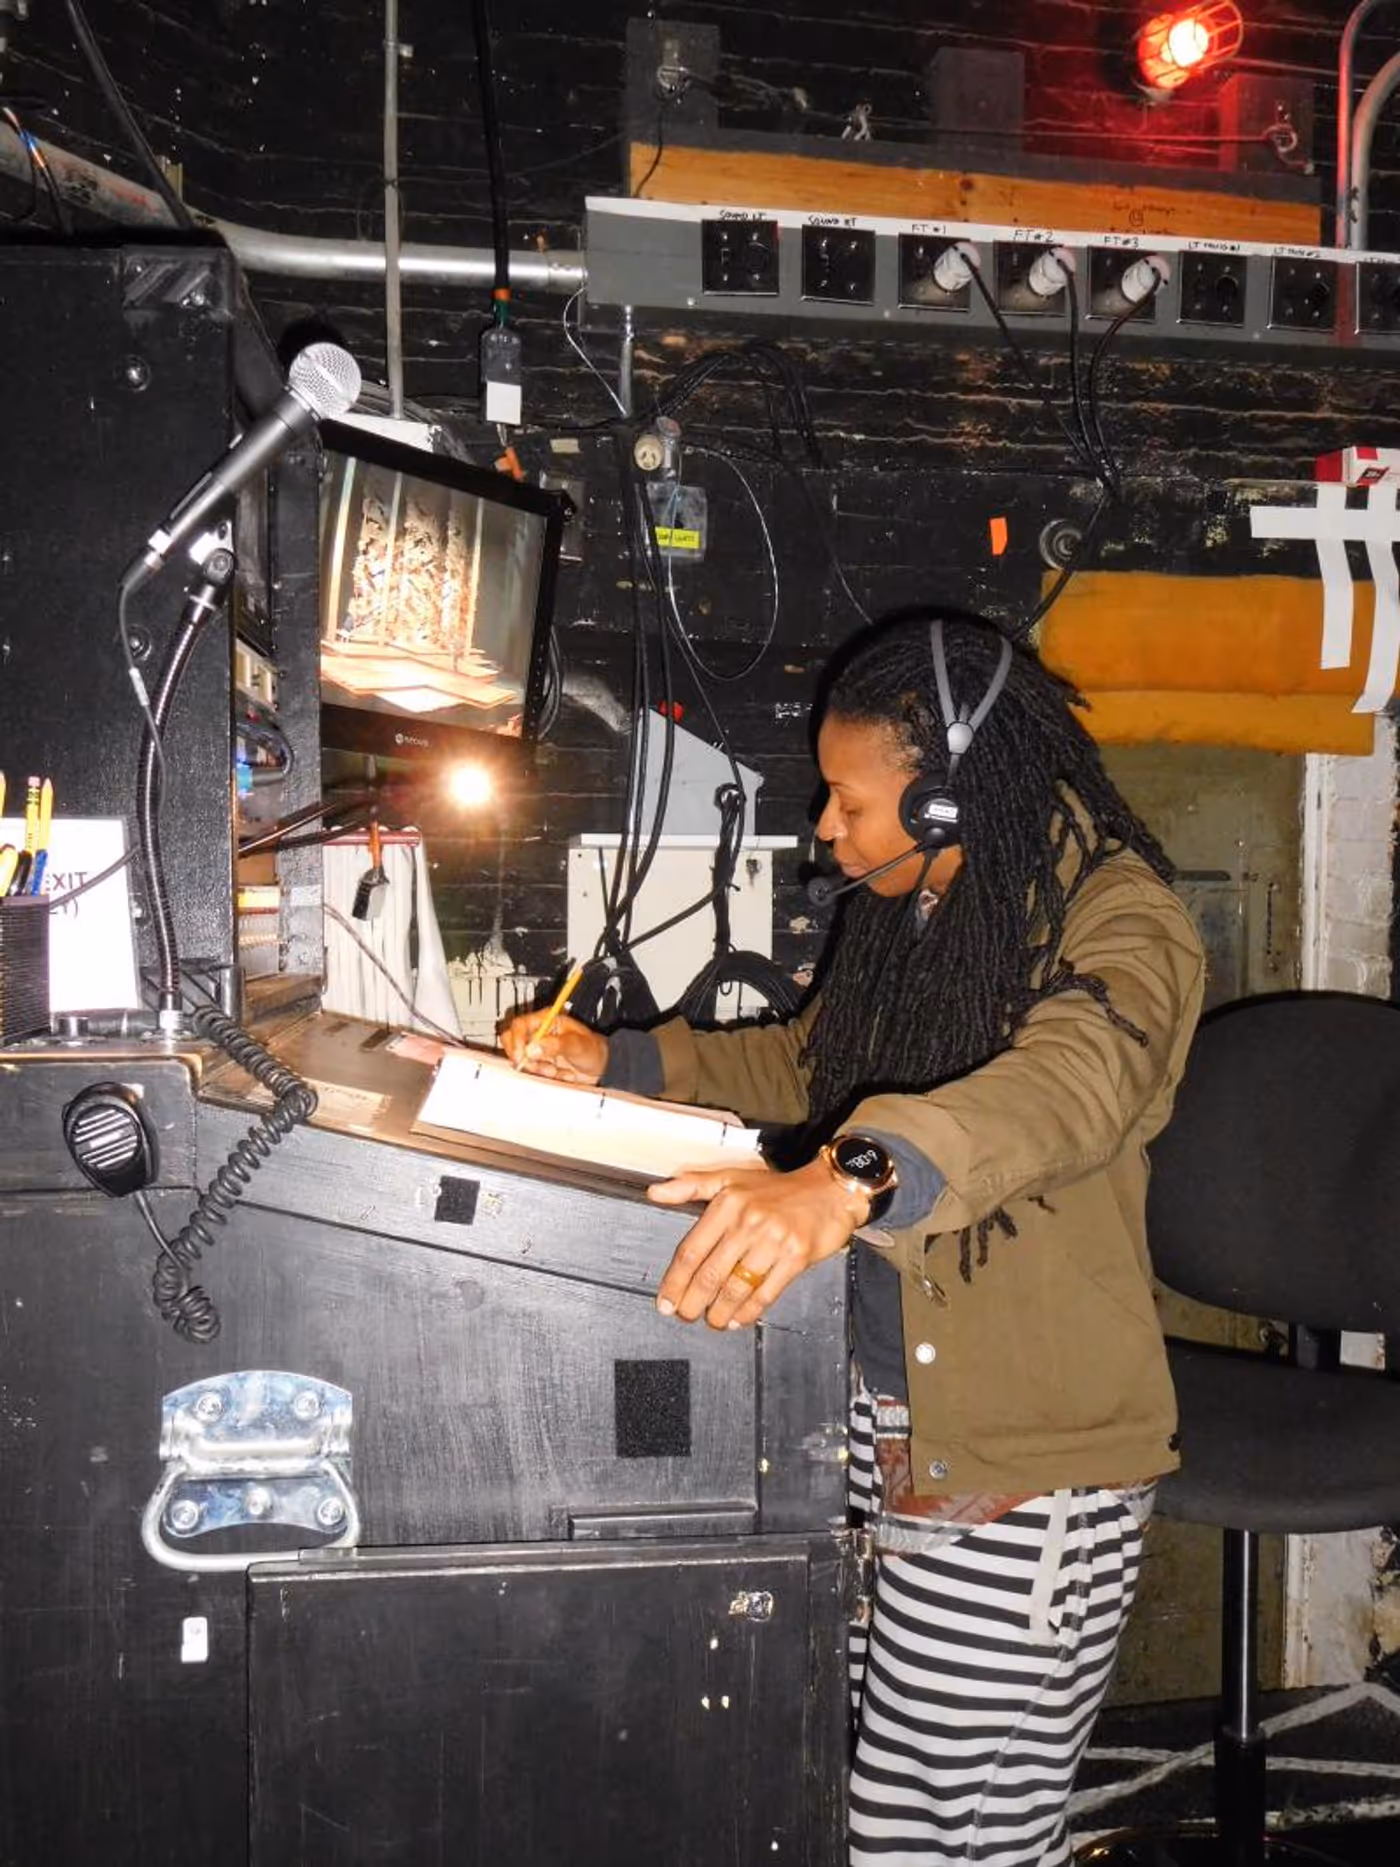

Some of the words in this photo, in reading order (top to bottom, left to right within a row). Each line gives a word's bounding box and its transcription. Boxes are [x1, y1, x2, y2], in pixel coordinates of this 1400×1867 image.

[808, 215, 839, 226] SOUND
[911, 224, 928, 233] FT
[1013, 229, 1034, 241] FT
[1104, 236, 1121, 245] FT
